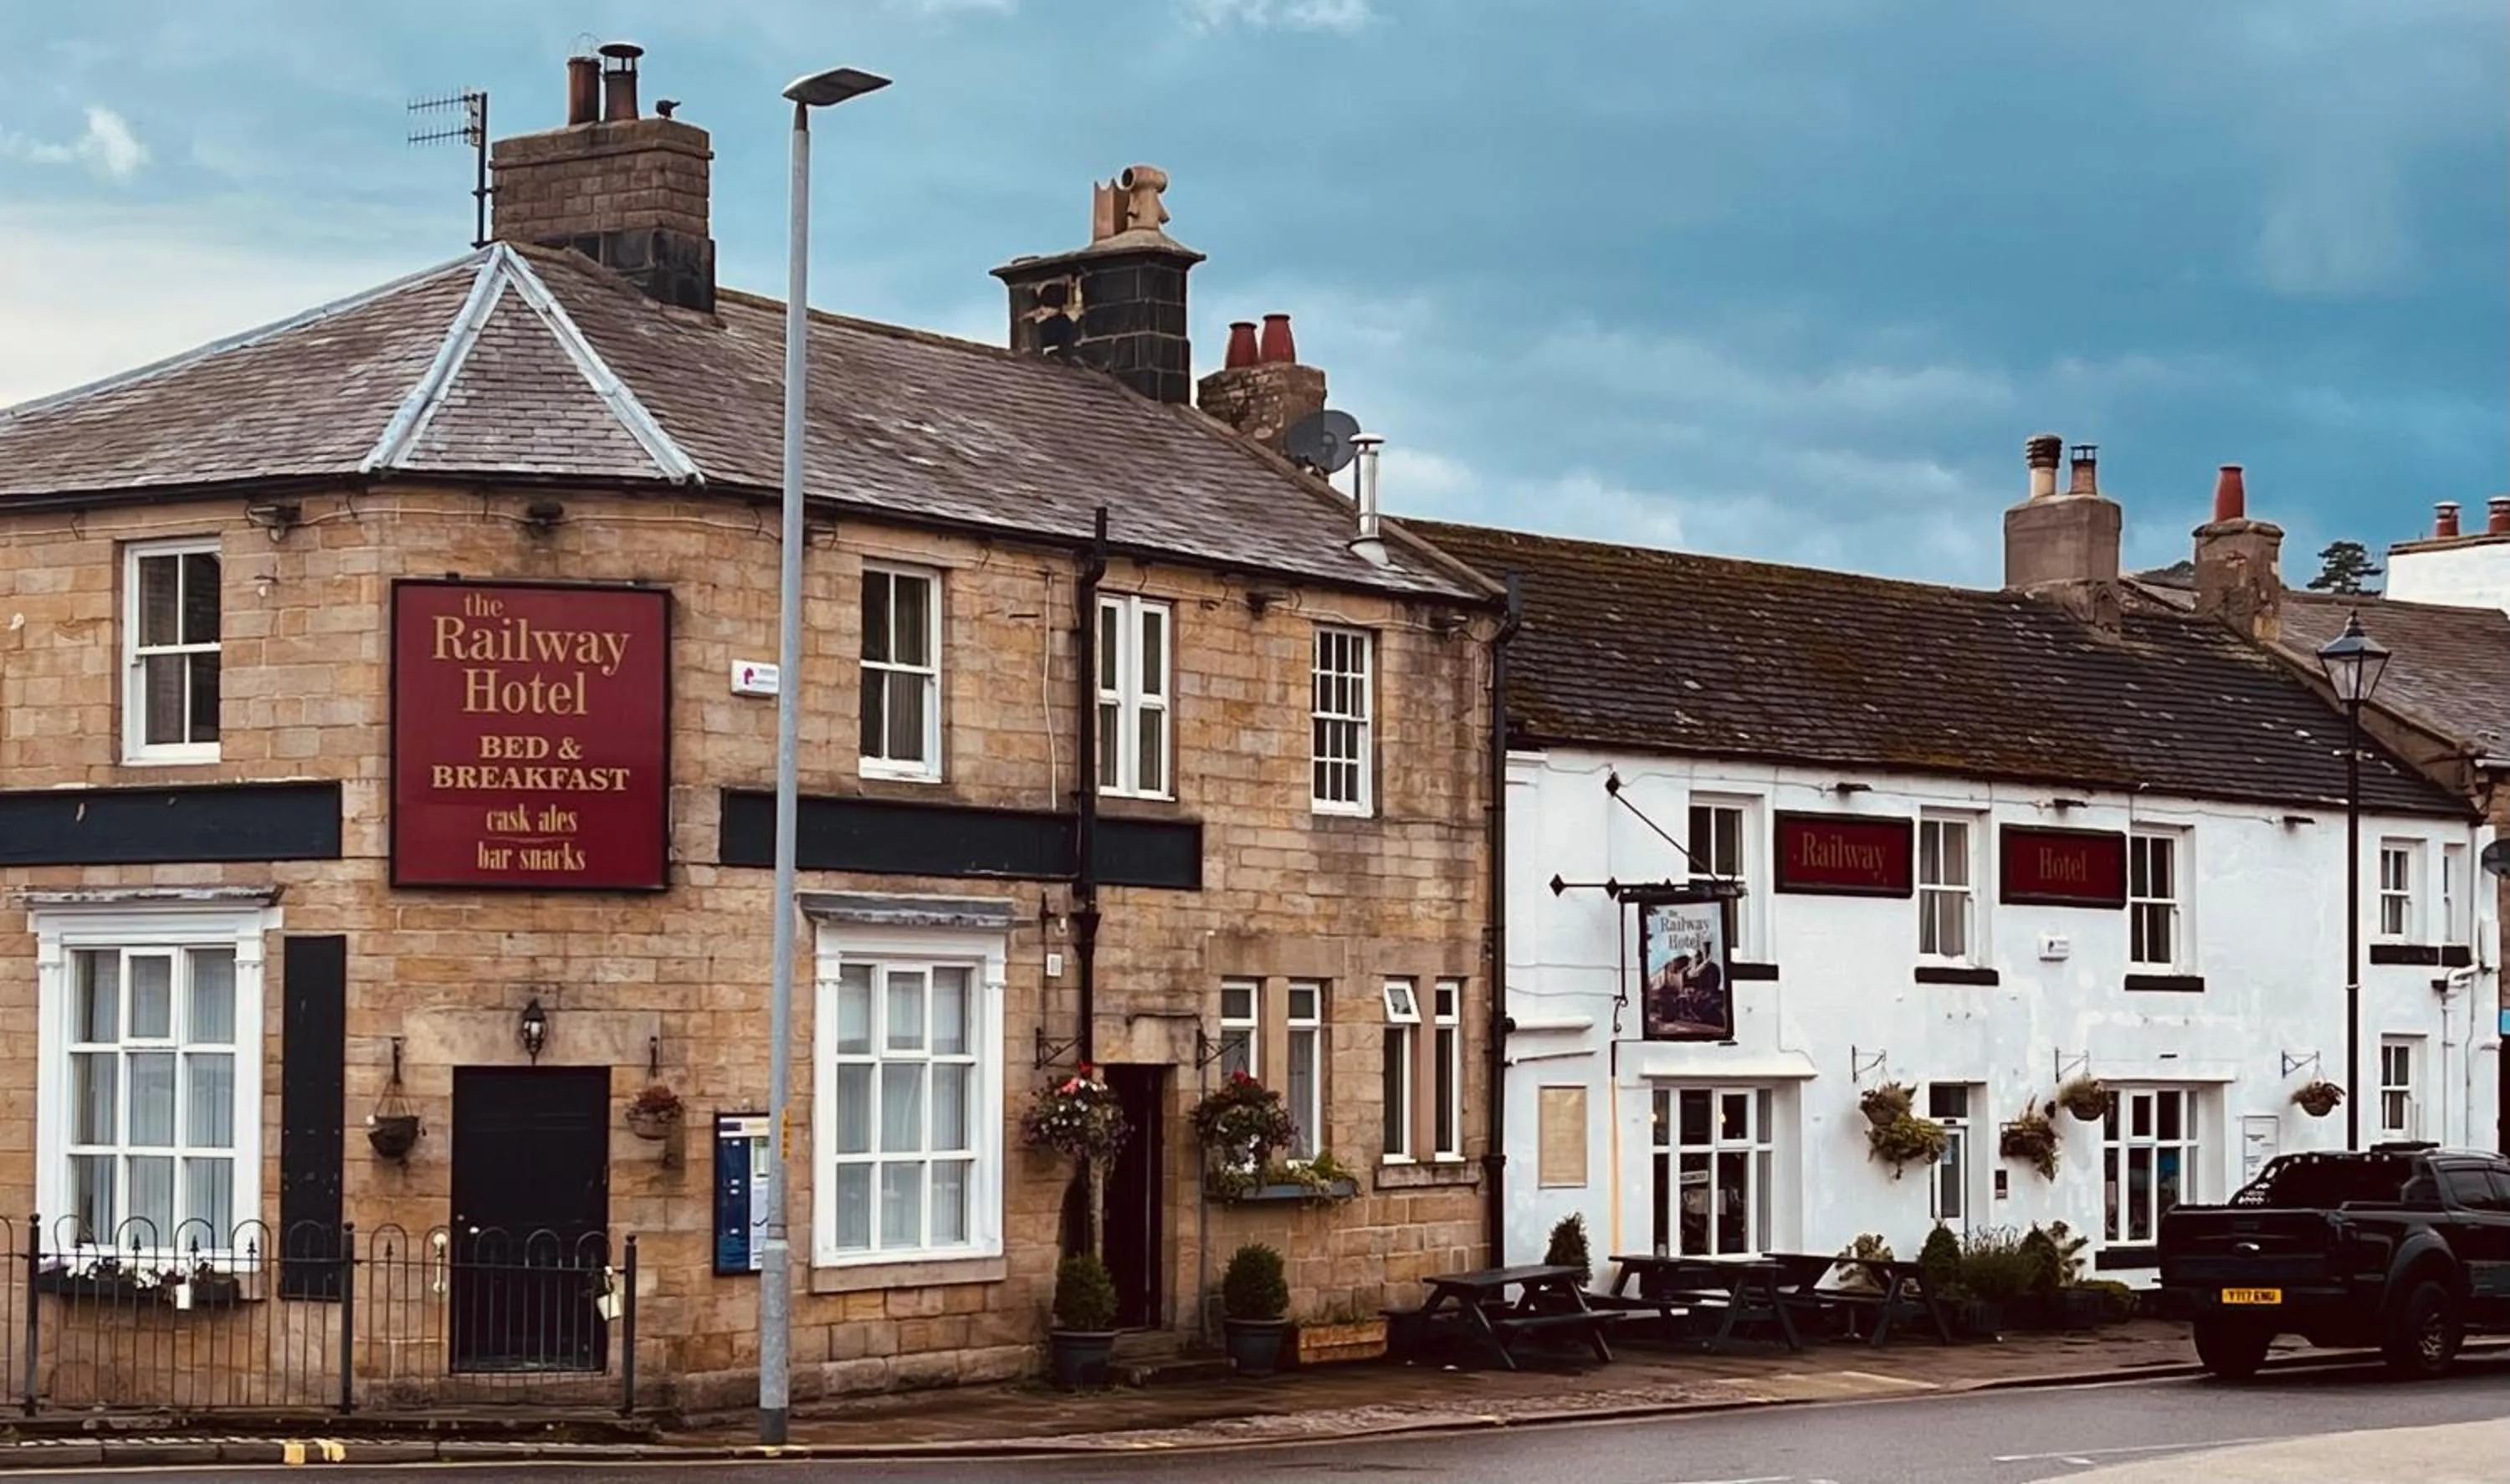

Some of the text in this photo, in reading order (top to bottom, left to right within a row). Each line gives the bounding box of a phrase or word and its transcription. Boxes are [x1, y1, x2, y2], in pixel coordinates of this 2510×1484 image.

[464, 593, 504, 617] the
[432, 616, 632, 676] Railway
[462, 669, 588, 715] Hotel
[479, 735, 583, 760] BED &
[432, 765, 630, 791] BREAKFAST
[485, 804, 577, 833] cask ales
[477, 841, 586, 872] bar snacks
[1801, 831, 1887, 878] Railway
[2038, 847, 2088, 883] Hotel
[1660, 917, 1709, 934] Railway
[1668, 934, 1701, 949] Hotel
